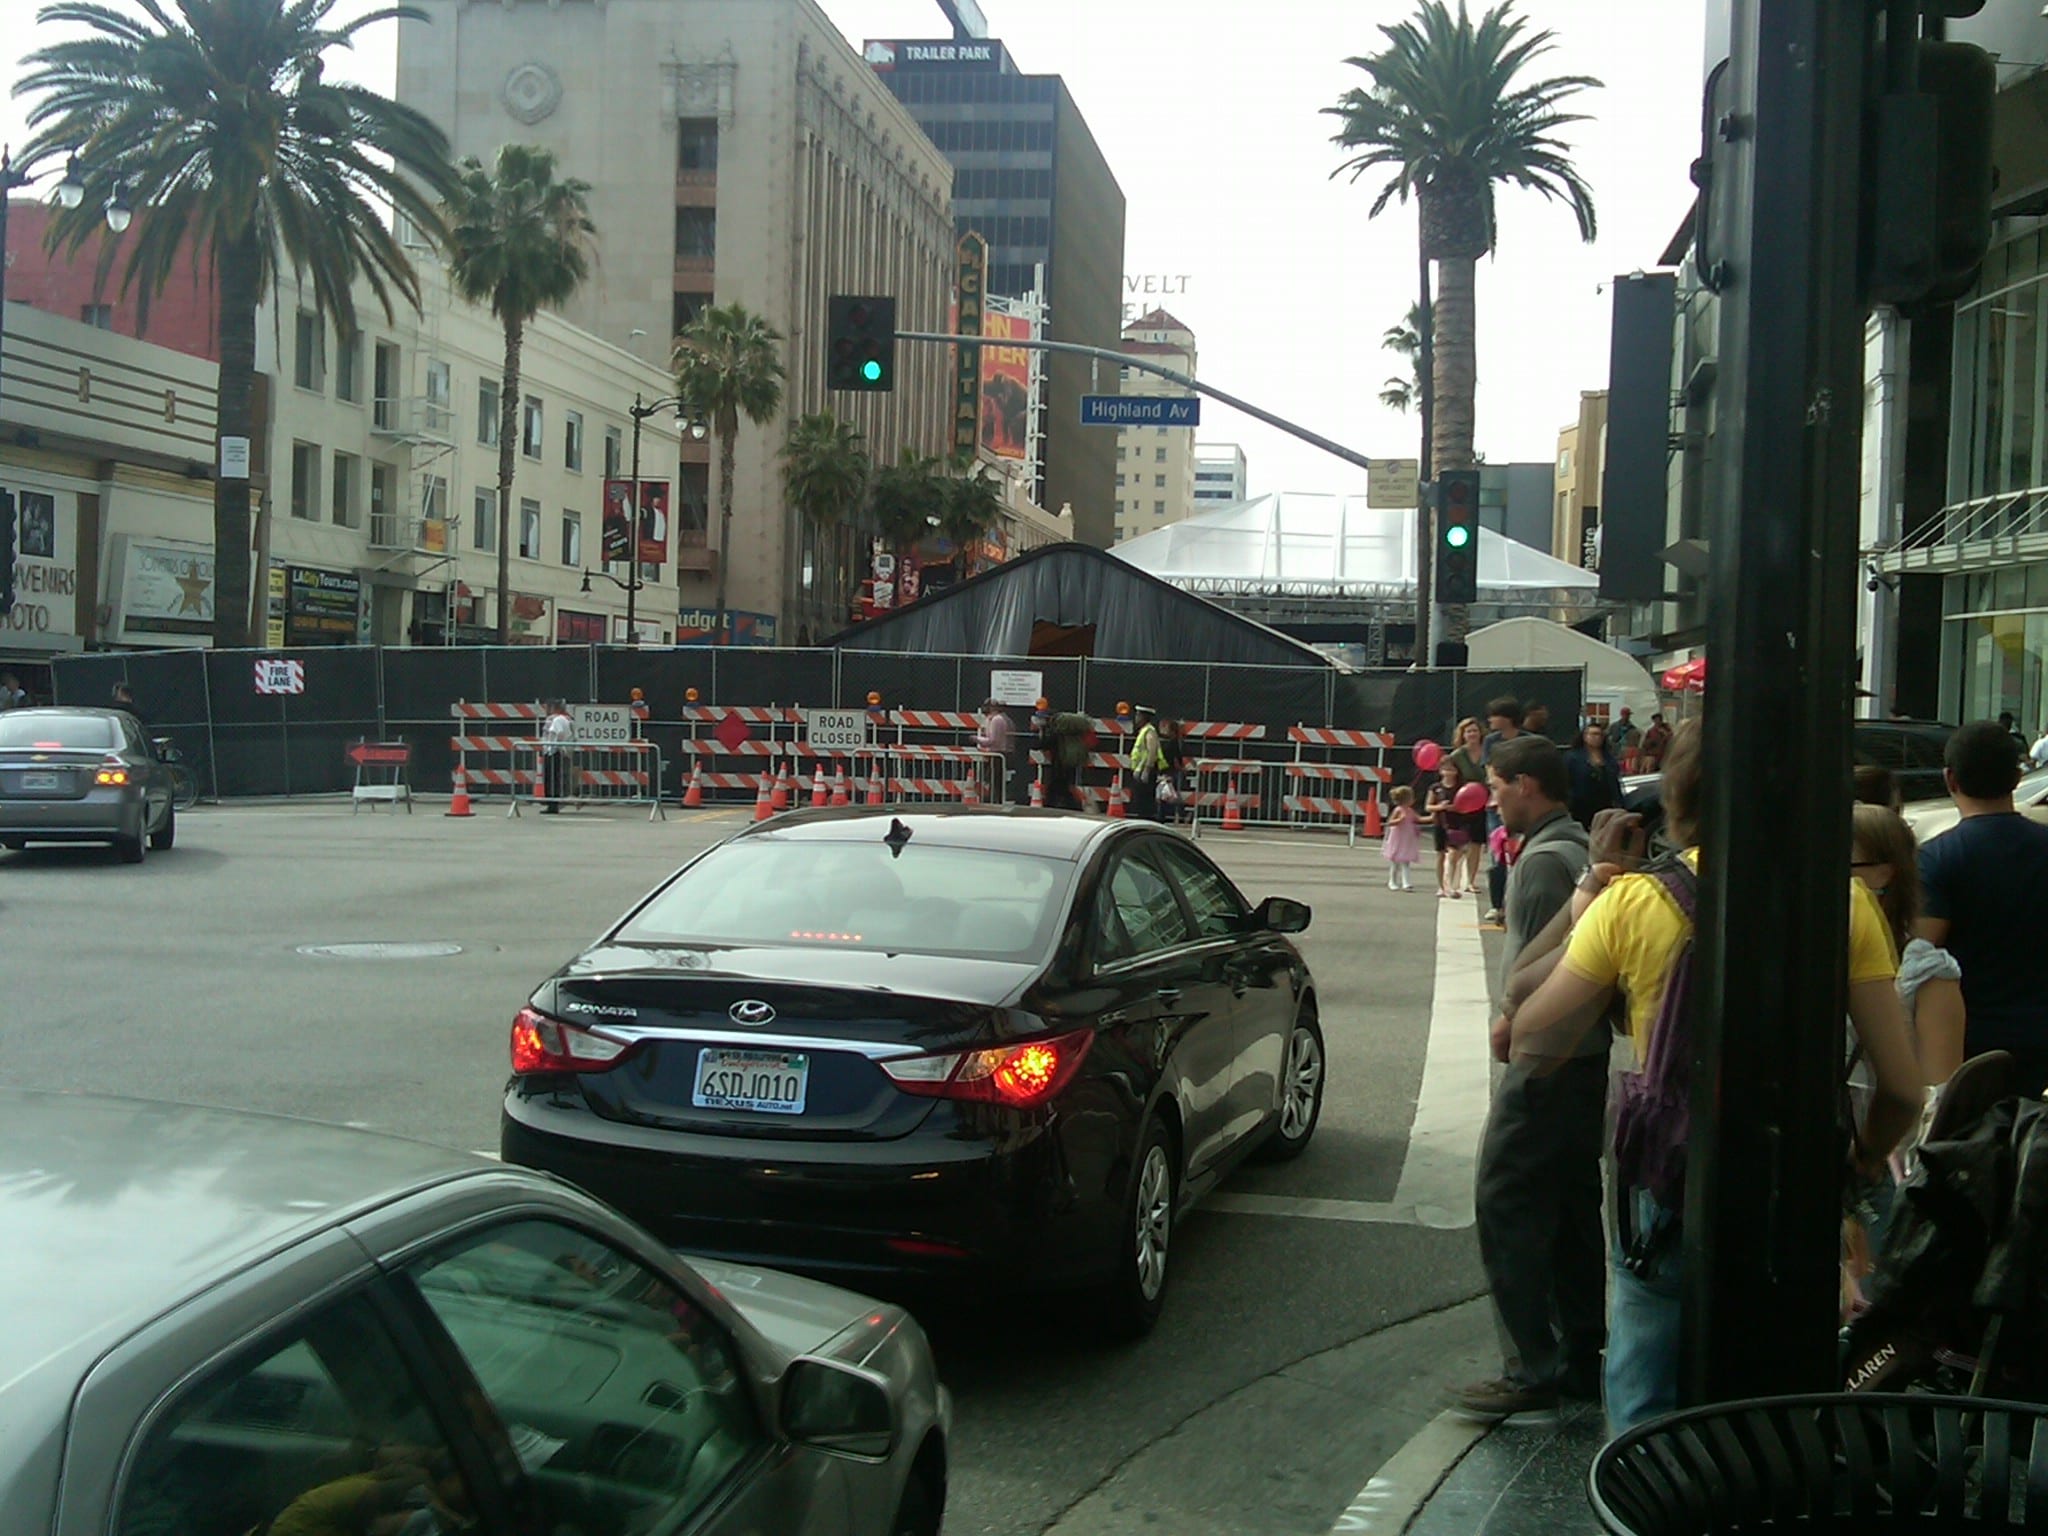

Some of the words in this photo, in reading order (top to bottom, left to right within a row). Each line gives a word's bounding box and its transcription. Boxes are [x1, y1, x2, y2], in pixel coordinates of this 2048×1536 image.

[906, 46, 956, 60] TRAILER
[958, 47, 991, 60] PARK
[1092, 401, 1161, 421] Highland
[1169, 404, 1190, 418] Av
[270, 666, 288, 676] FIRE
[268, 676, 291, 686] LANE
[584, 711, 620, 722] ROAD
[819, 715, 854, 729] ROAD
[578, 727, 627, 740] CLOSED
[811, 732, 862, 745] CLOSED
[565, 1003, 638, 1017] SONATA
[702, 1070, 799, 1102] 6SDJ010
